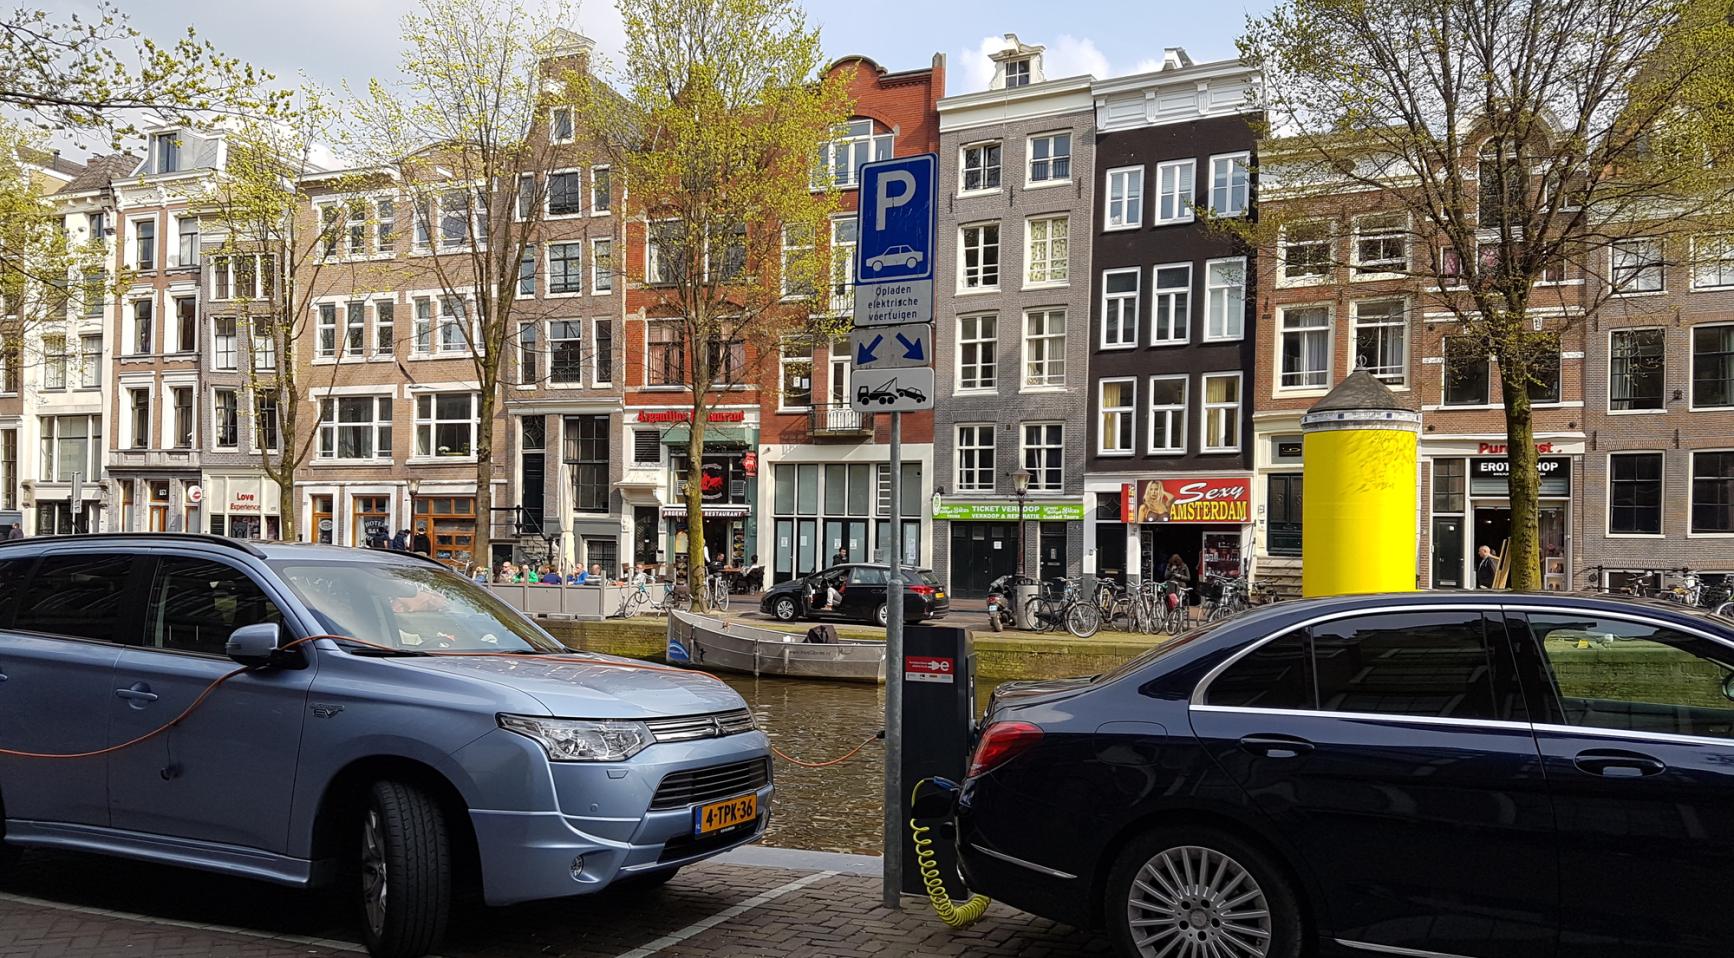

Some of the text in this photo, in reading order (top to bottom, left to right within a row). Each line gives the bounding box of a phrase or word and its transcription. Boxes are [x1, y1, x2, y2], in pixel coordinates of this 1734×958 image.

[875, 169, 917, 232] P
[875, 285, 912, 297] Opladen
[867, 297, 919, 309] elektrische
[868, 311, 918, 322] voertuigen
[236, 492, 255, 501] Love
[1174, 482, 1245, 505] Sexy
[230, 503, 261, 512] Experience
[1169, 501, 1248, 520] AMSTERDAM
[706, 799, 753, 827] 4-TPK-36
